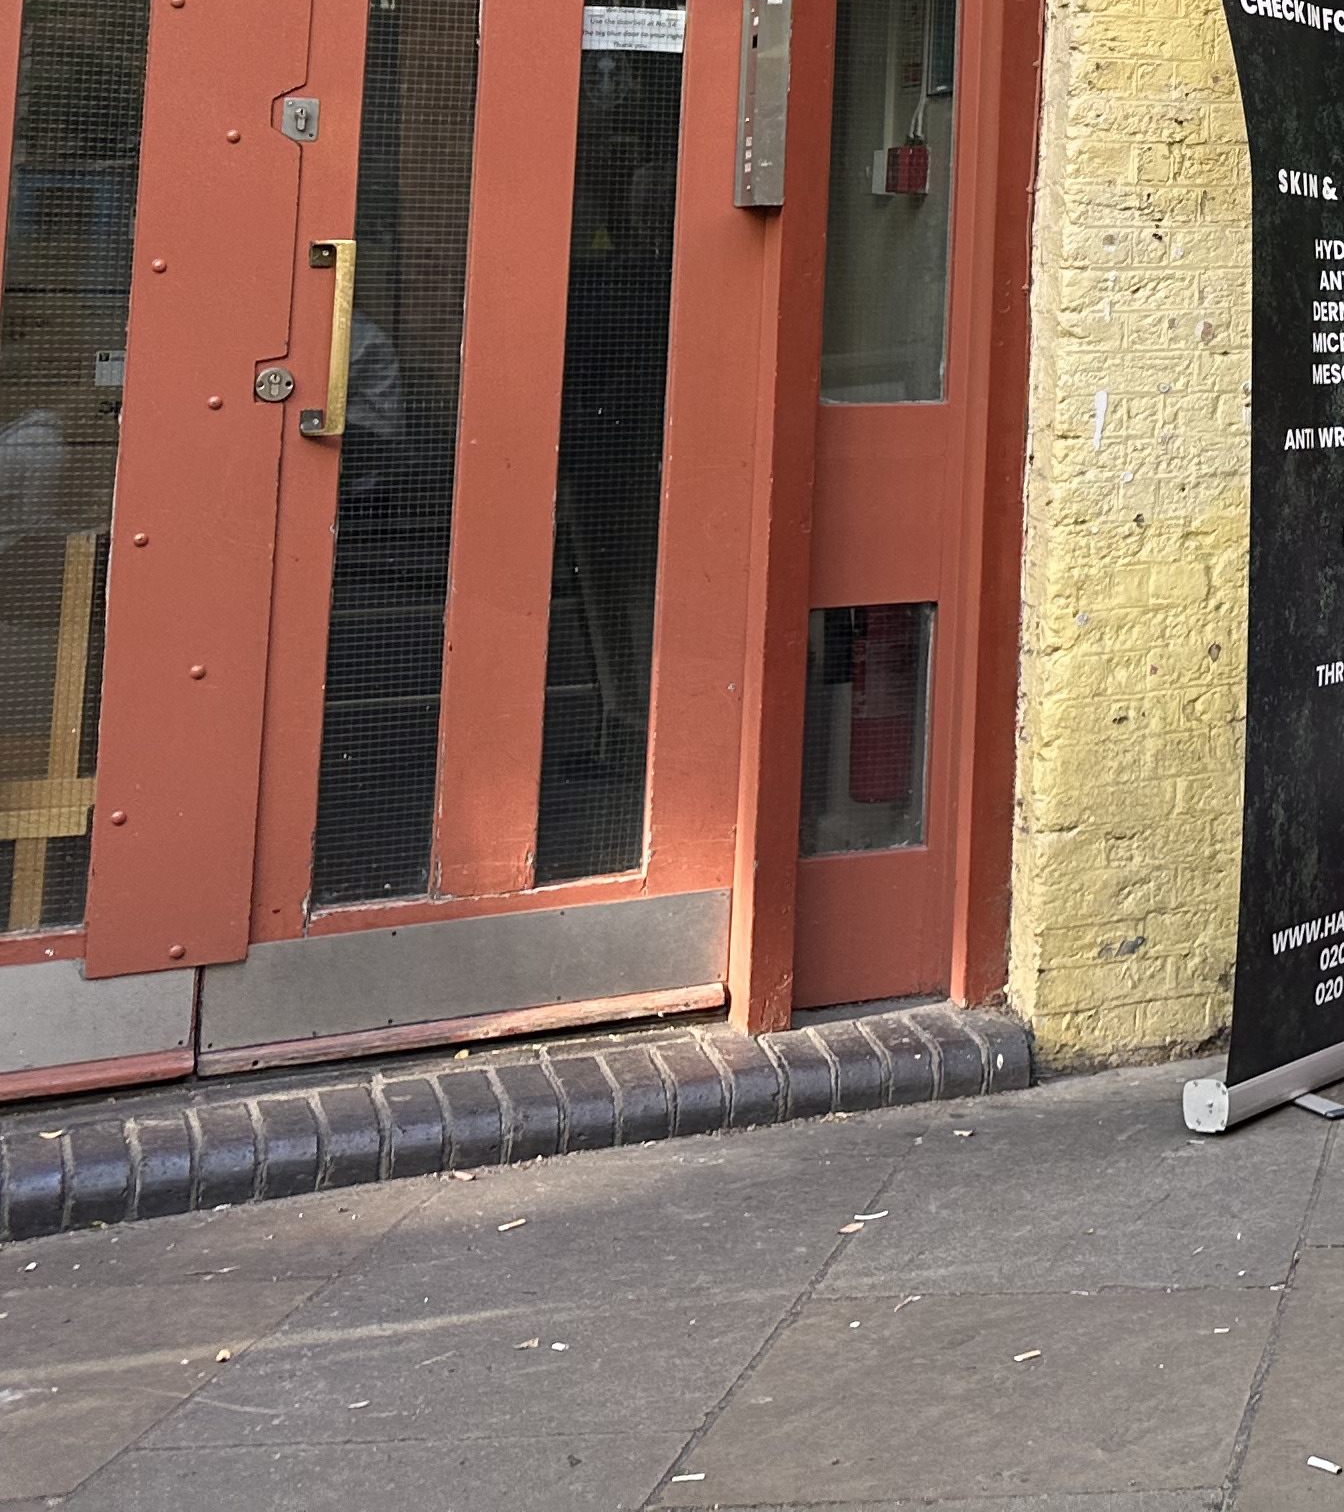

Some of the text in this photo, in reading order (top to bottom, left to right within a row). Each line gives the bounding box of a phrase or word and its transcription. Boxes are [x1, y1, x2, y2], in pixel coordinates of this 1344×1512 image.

[1307, 1, 1321, 28] IN
[1278, 168, 1319, 199] SKIN
[1322, 173, 1338, 201] &
[1284, 427, 1314, 451] ANTI
[1315, 976, 1343, 1006] 020
